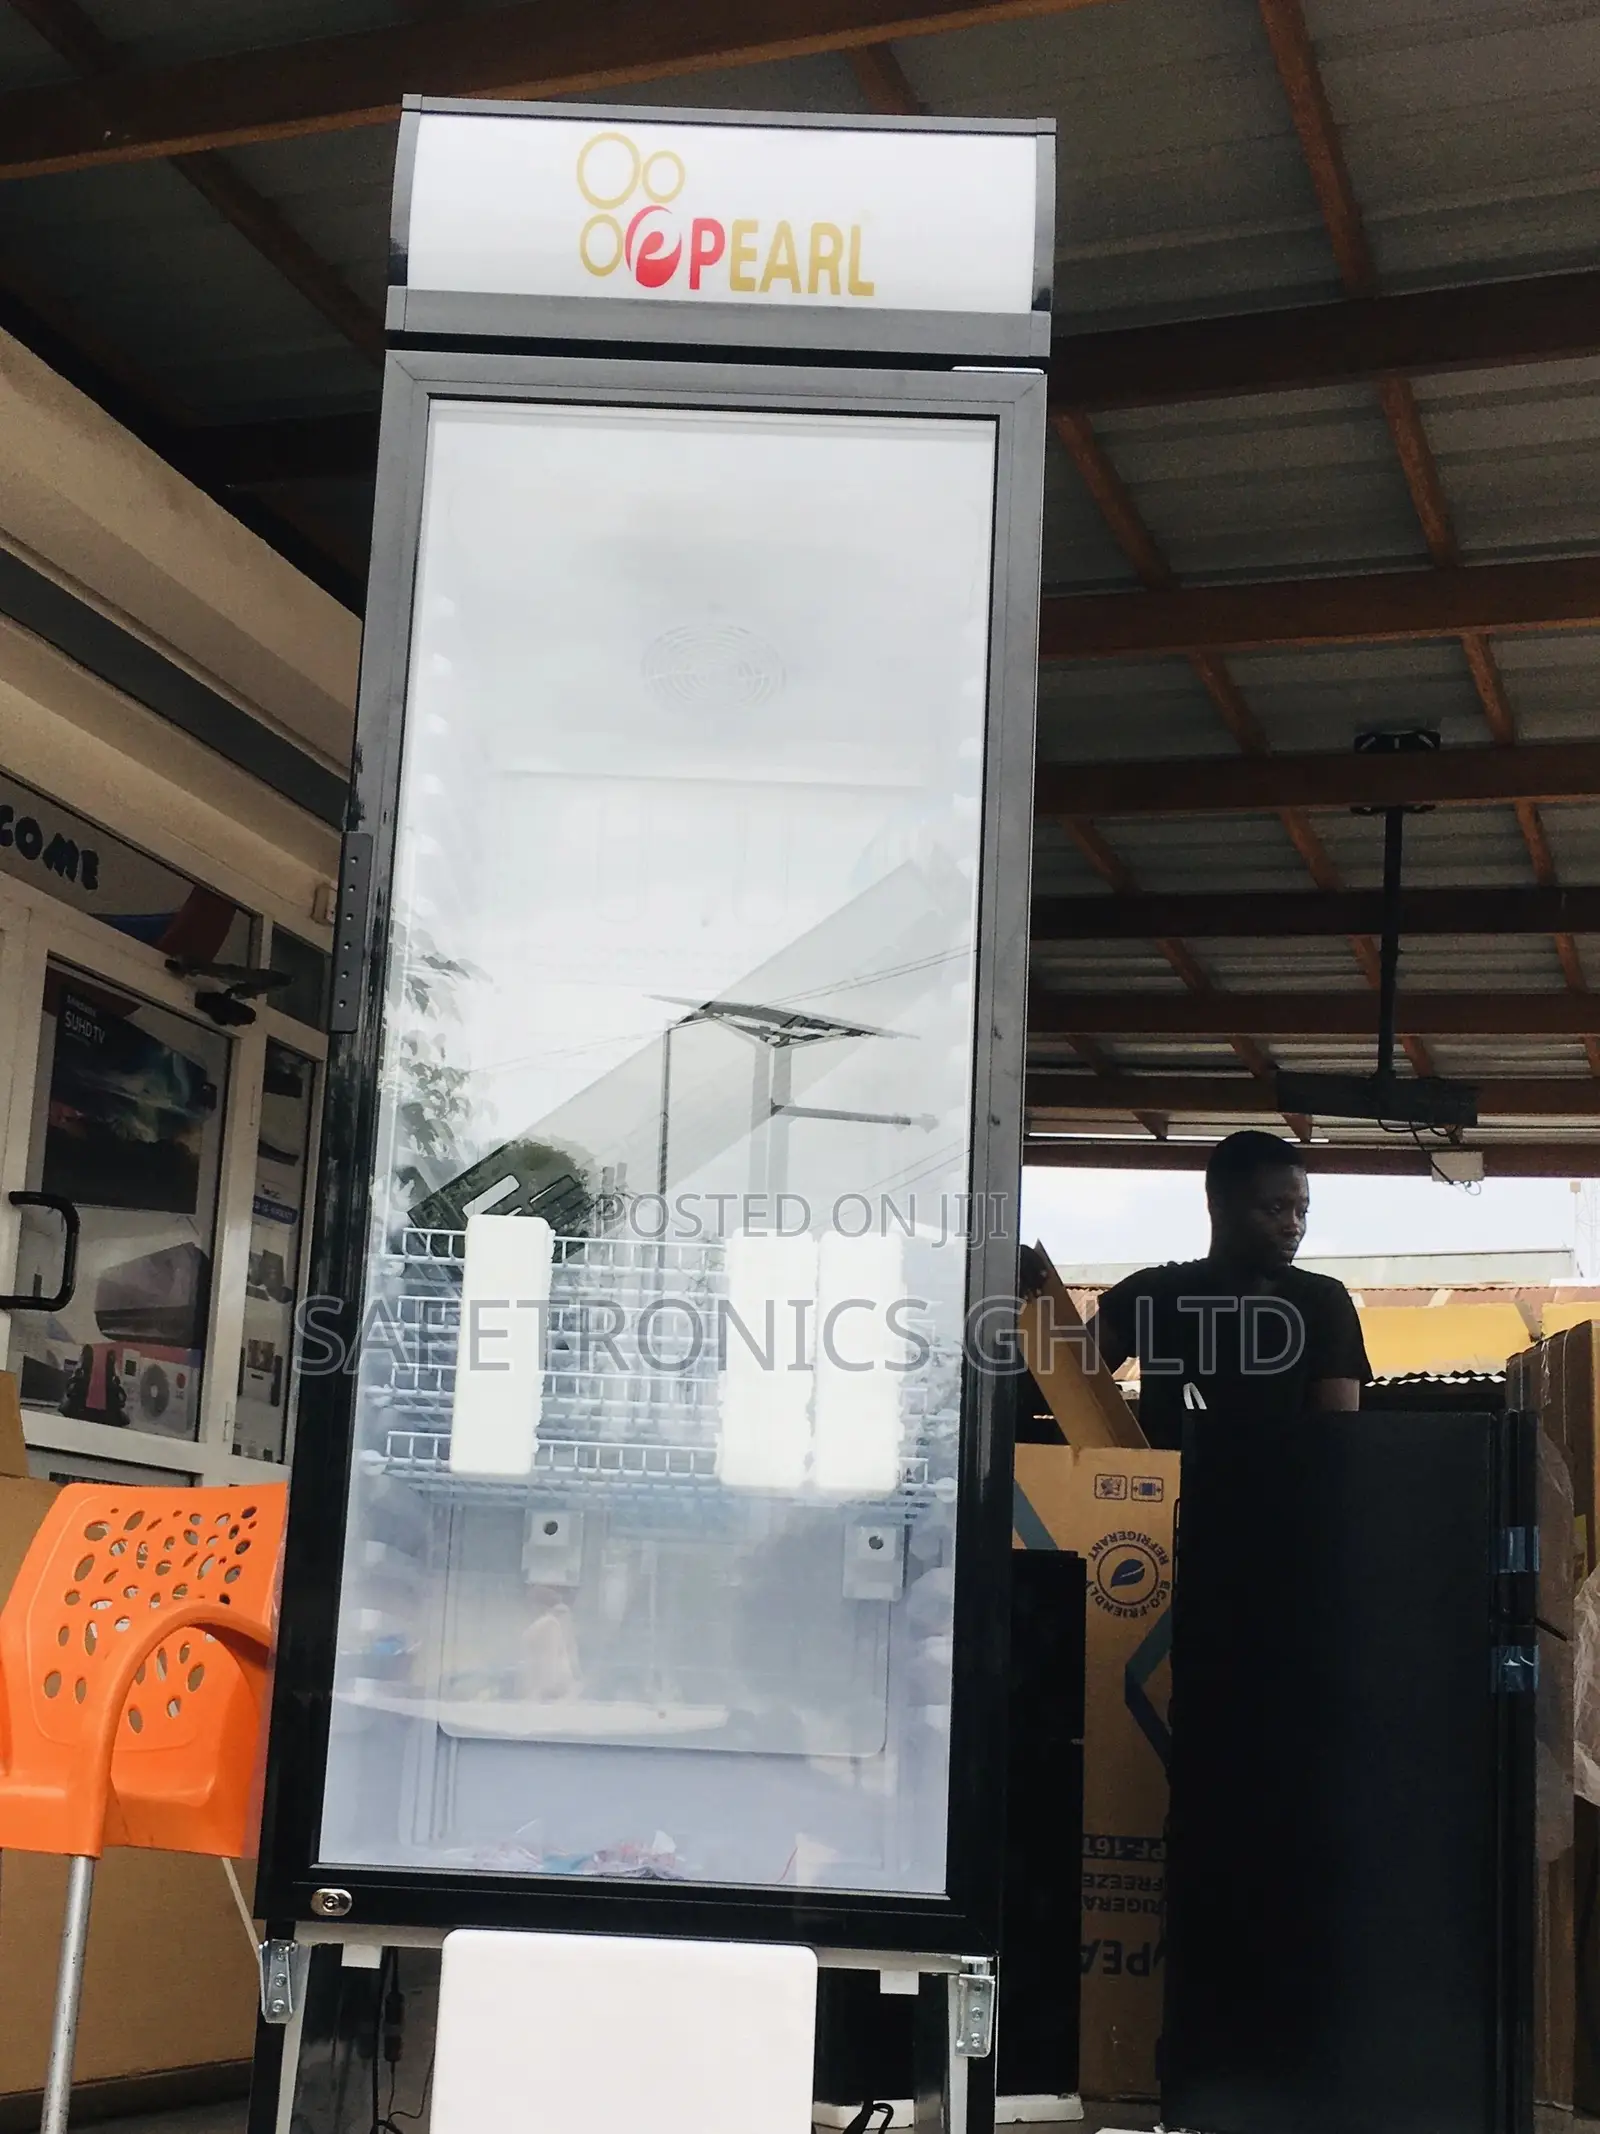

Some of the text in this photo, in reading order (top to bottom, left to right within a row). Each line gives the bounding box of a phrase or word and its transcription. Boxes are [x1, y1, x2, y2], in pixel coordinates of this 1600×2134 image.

[689, 217, 875, 297] PEARL
[93, 1025, 106, 1045] TV
[1088, 1530, 1170, 1566] REFRIGERANT
[1086, 1580, 1171, 1619] ECO-FRIENDLY
